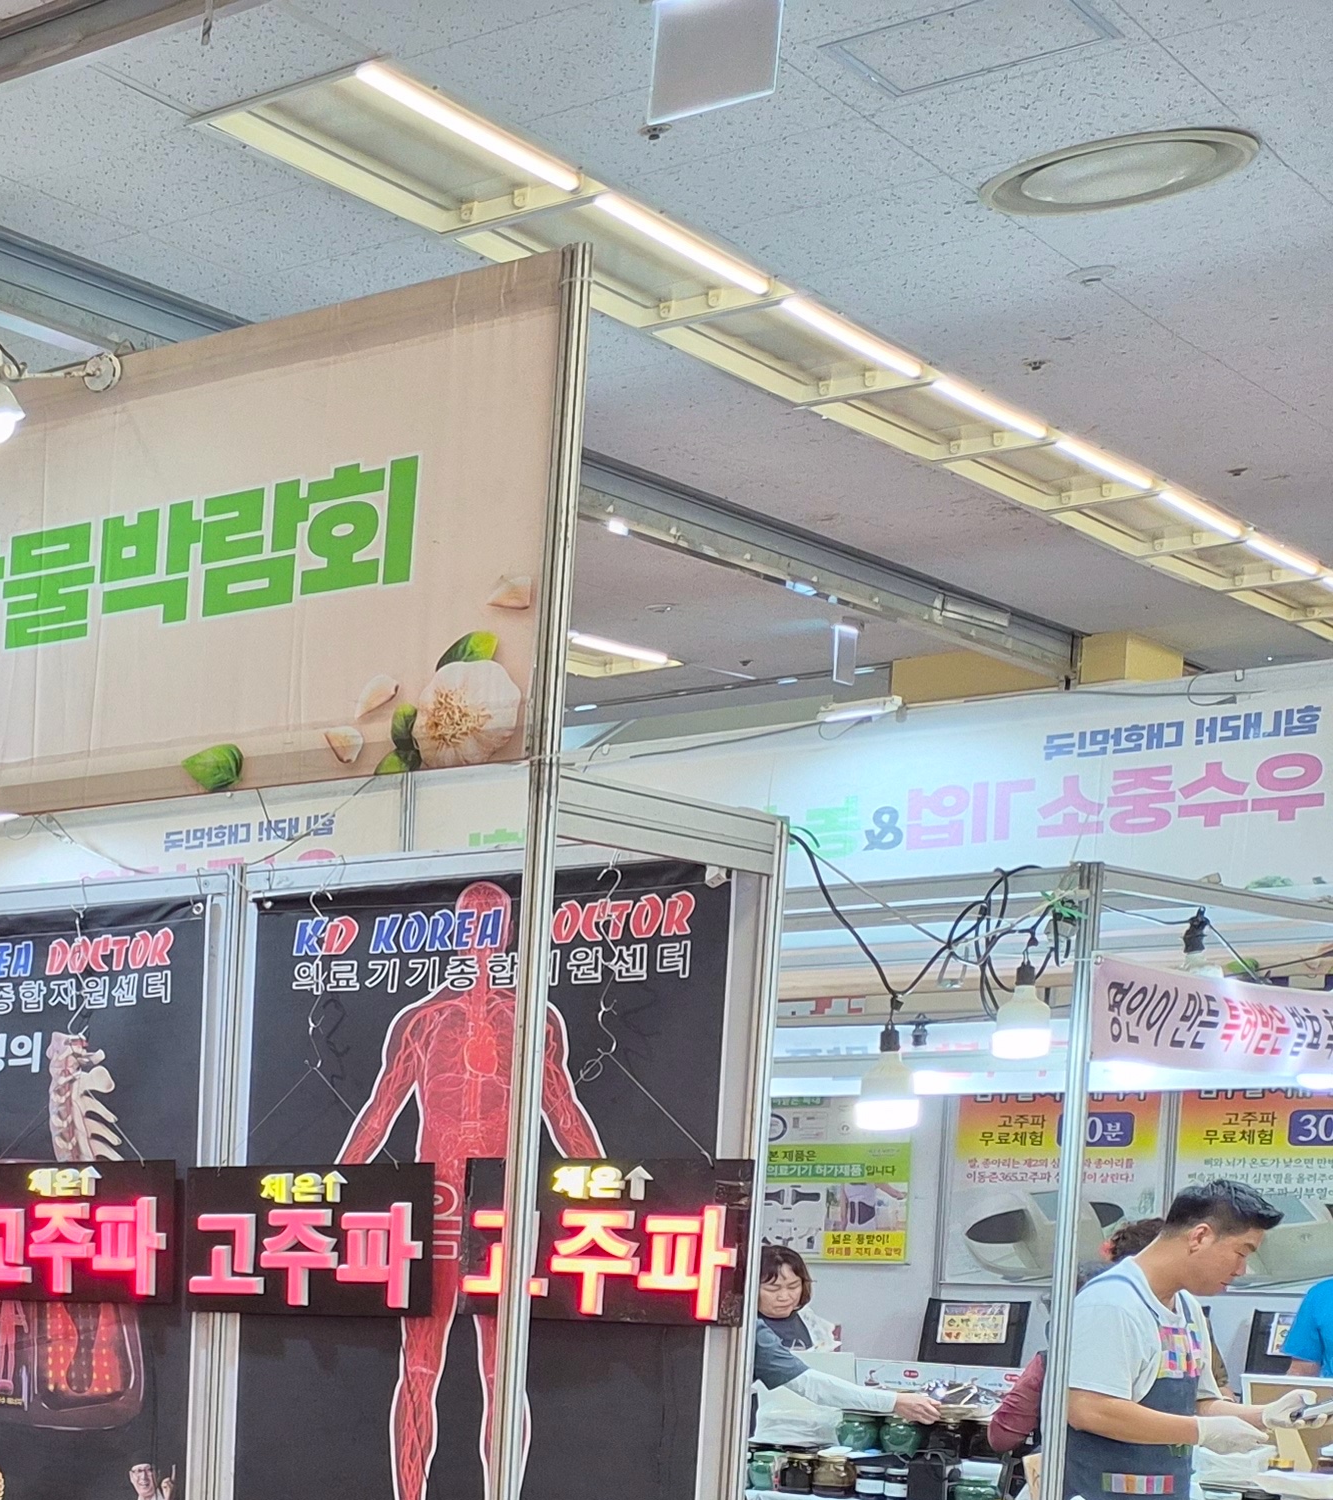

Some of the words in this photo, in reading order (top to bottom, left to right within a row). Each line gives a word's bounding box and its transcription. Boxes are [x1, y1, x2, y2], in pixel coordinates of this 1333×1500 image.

[292, 916, 360, 957] KD
[370, 908, 501, 953] KOREA
[551, 890, 696, 943] OCTOR
[46, 928, 173, 975] DOCTOR
[1107, 981, 1178, 1047] 명인이
[1170, 992, 1219, 1049] 만든
[998, 1115, 1046, 1128] 고주파
[1222, 1112, 1276, 1126] 고주파
[979, 1131, 1043, 1146] 무료체험
[1203, 1130, 1273, 1145] 무료체험
[782, 1150, 817, 1161] 제품은
[815, 1164, 863, 1176] 허가제품
[866, 1165, 896, 1176] 입니다
[188, 1201, 422, 1309] 고주파
